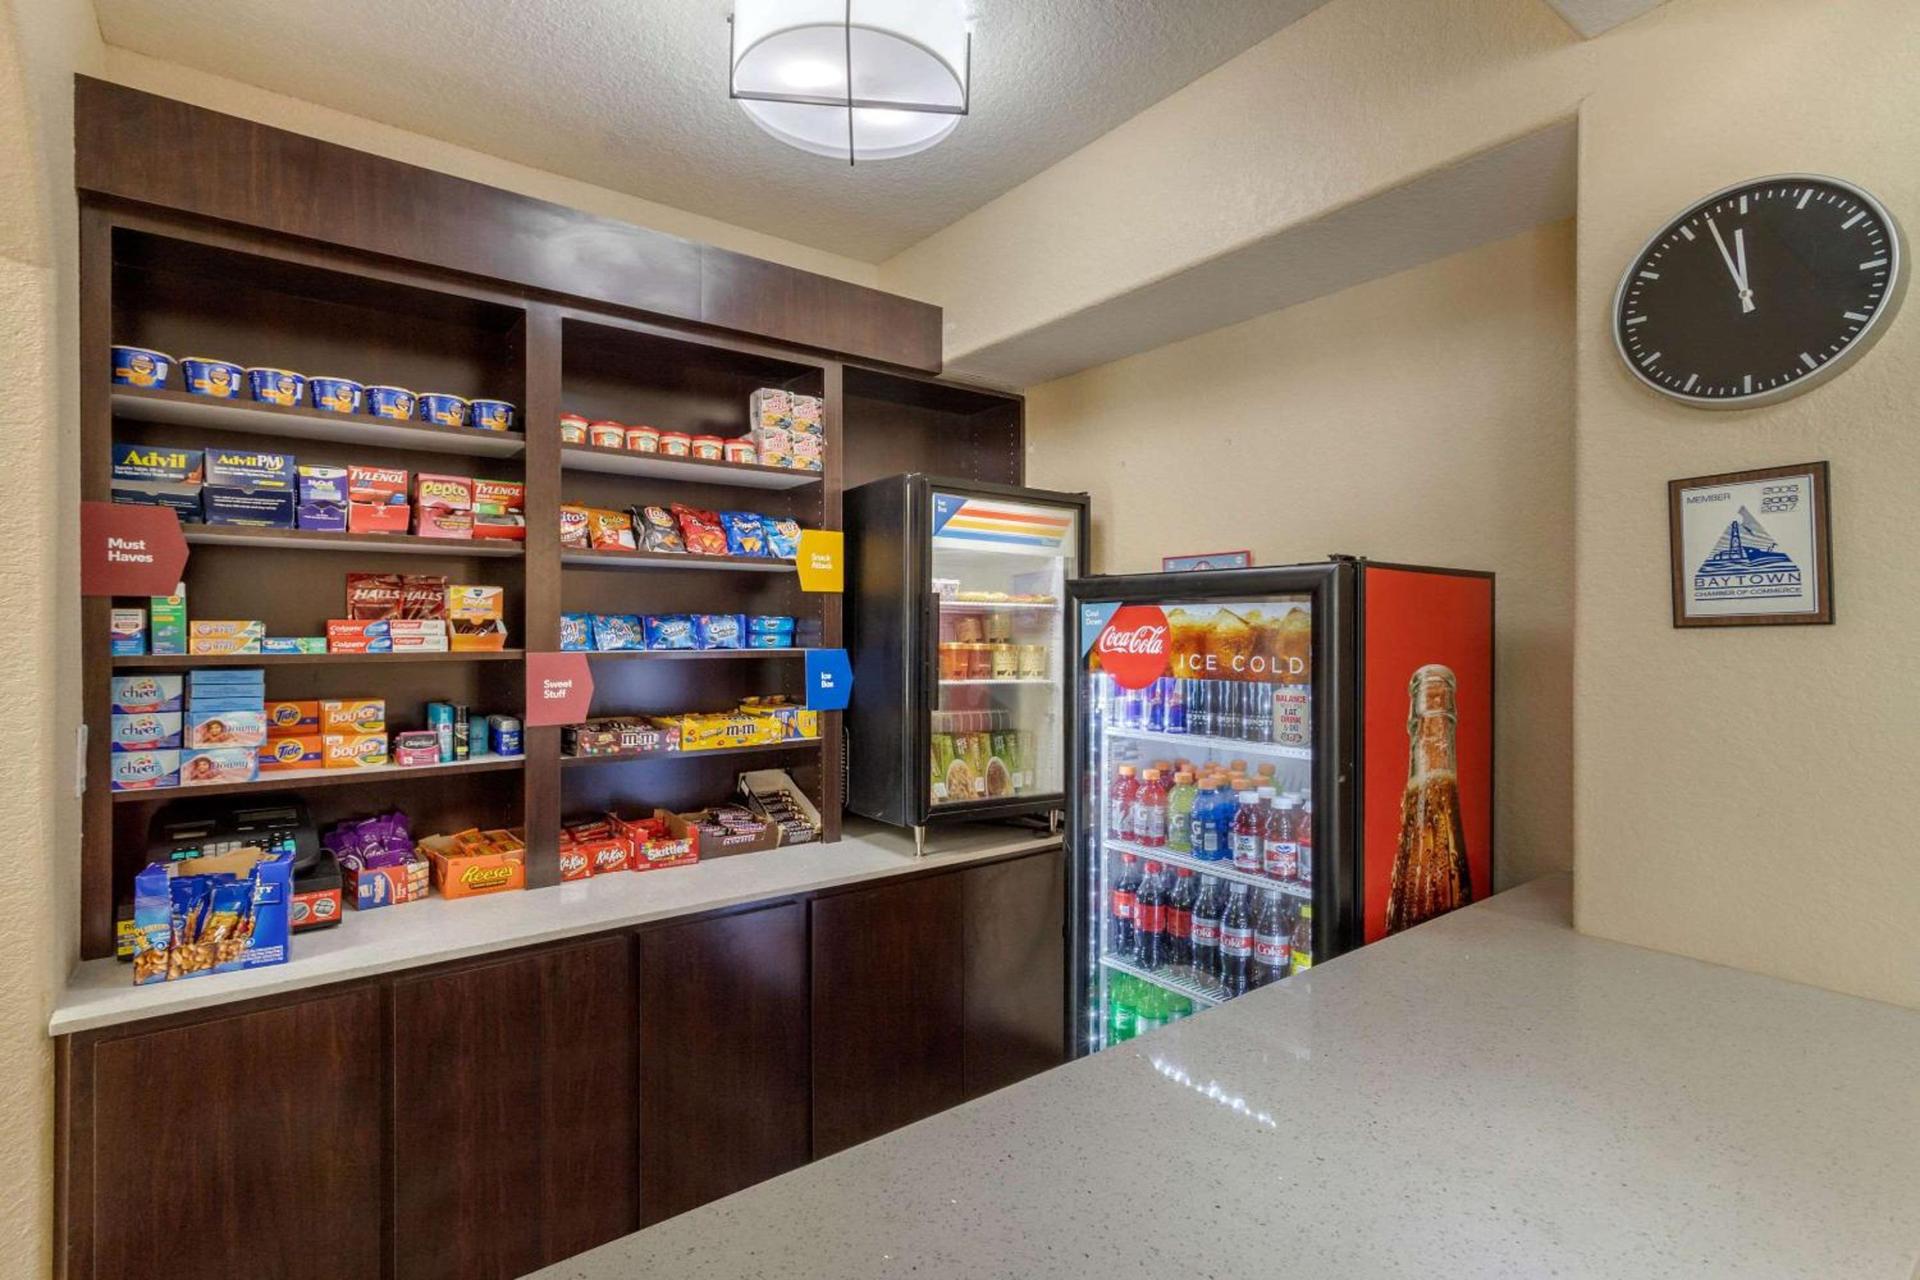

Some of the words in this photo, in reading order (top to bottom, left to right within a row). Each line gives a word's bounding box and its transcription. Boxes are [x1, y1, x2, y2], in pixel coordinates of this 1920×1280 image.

[122, 449, 186, 469] Advil
[217, 454, 257, 467] Advil
[257, 454, 284, 471] PM
[350, 469, 404, 484] TYLENOL
[475, 483, 521, 496] TYLENOL
[1686, 492, 1731, 504] MEMBER
[1762, 495, 1800, 505] 2006
[1761, 503, 1798, 513] 2007
[108, 537, 146, 550] Must
[108, 551, 154, 563] Haves
[1694, 573, 1801, 587] BAYTOWN
[353, 588, 400, 600] HALLS
[1695, 588, 1735, 597] CHAMBER
[1736, 588, 1748, 596] OF
[1750, 586, 1801, 596] COMMERCE
[1100, 624, 1168, 655] Coca-Cola
[1180, 653, 1218, 671] ICE
[1232, 655, 1304, 674] COLD
[543, 679, 572, 689] Sweet
[122, 685, 159, 699] cheer
[543, 689, 567, 699] Stuff
[1275, 694, 1307, 704] BALANCE
[276, 708, 298, 722] Tide
[121, 722, 160, 737] cheer
[278, 743, 302, 759] Tide
[119, 761, 159, 775] cheer
[647, 842, 690, 861] Skittles
[1257, 943, 1284, 957] Coke
